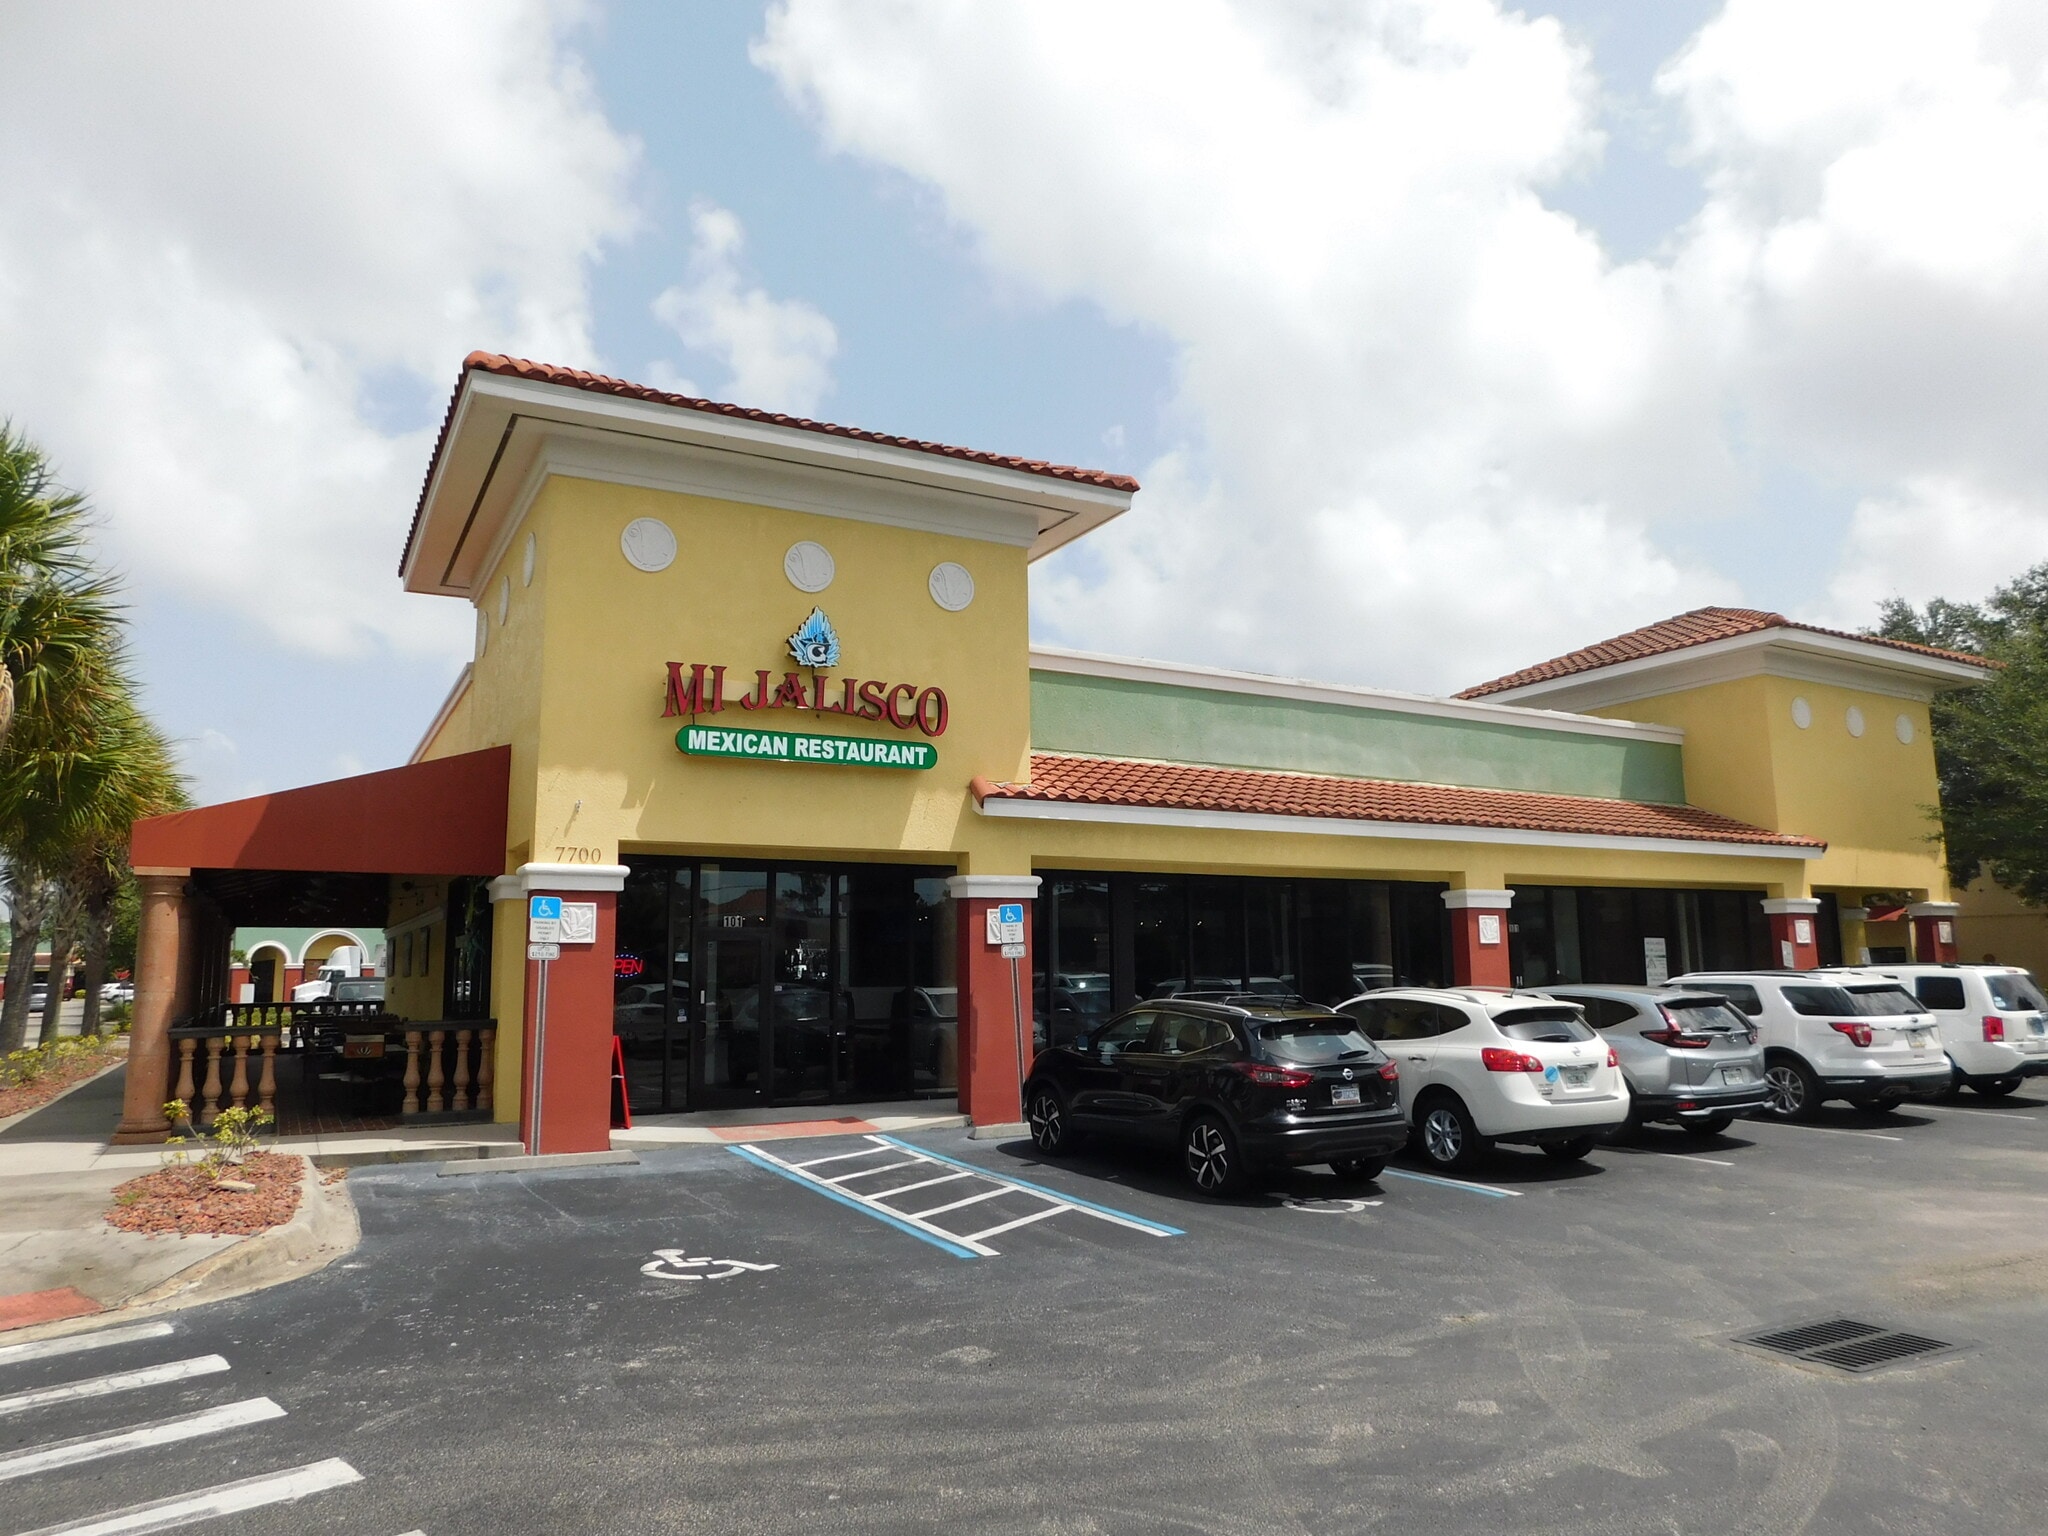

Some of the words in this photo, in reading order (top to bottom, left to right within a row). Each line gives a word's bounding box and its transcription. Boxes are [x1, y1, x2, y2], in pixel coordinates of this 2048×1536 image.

[661, 661, 728, 718] MI
[740, 669, 949, 737] JALISCO
[688, 729, 788, 756] MEXICAN
[795, 737, 928, 766] RESTAURANT
[555, 846, 602, 864] 7700
[724, 915, 743, 928] 101
[614, 958, 643, 974] PEN
